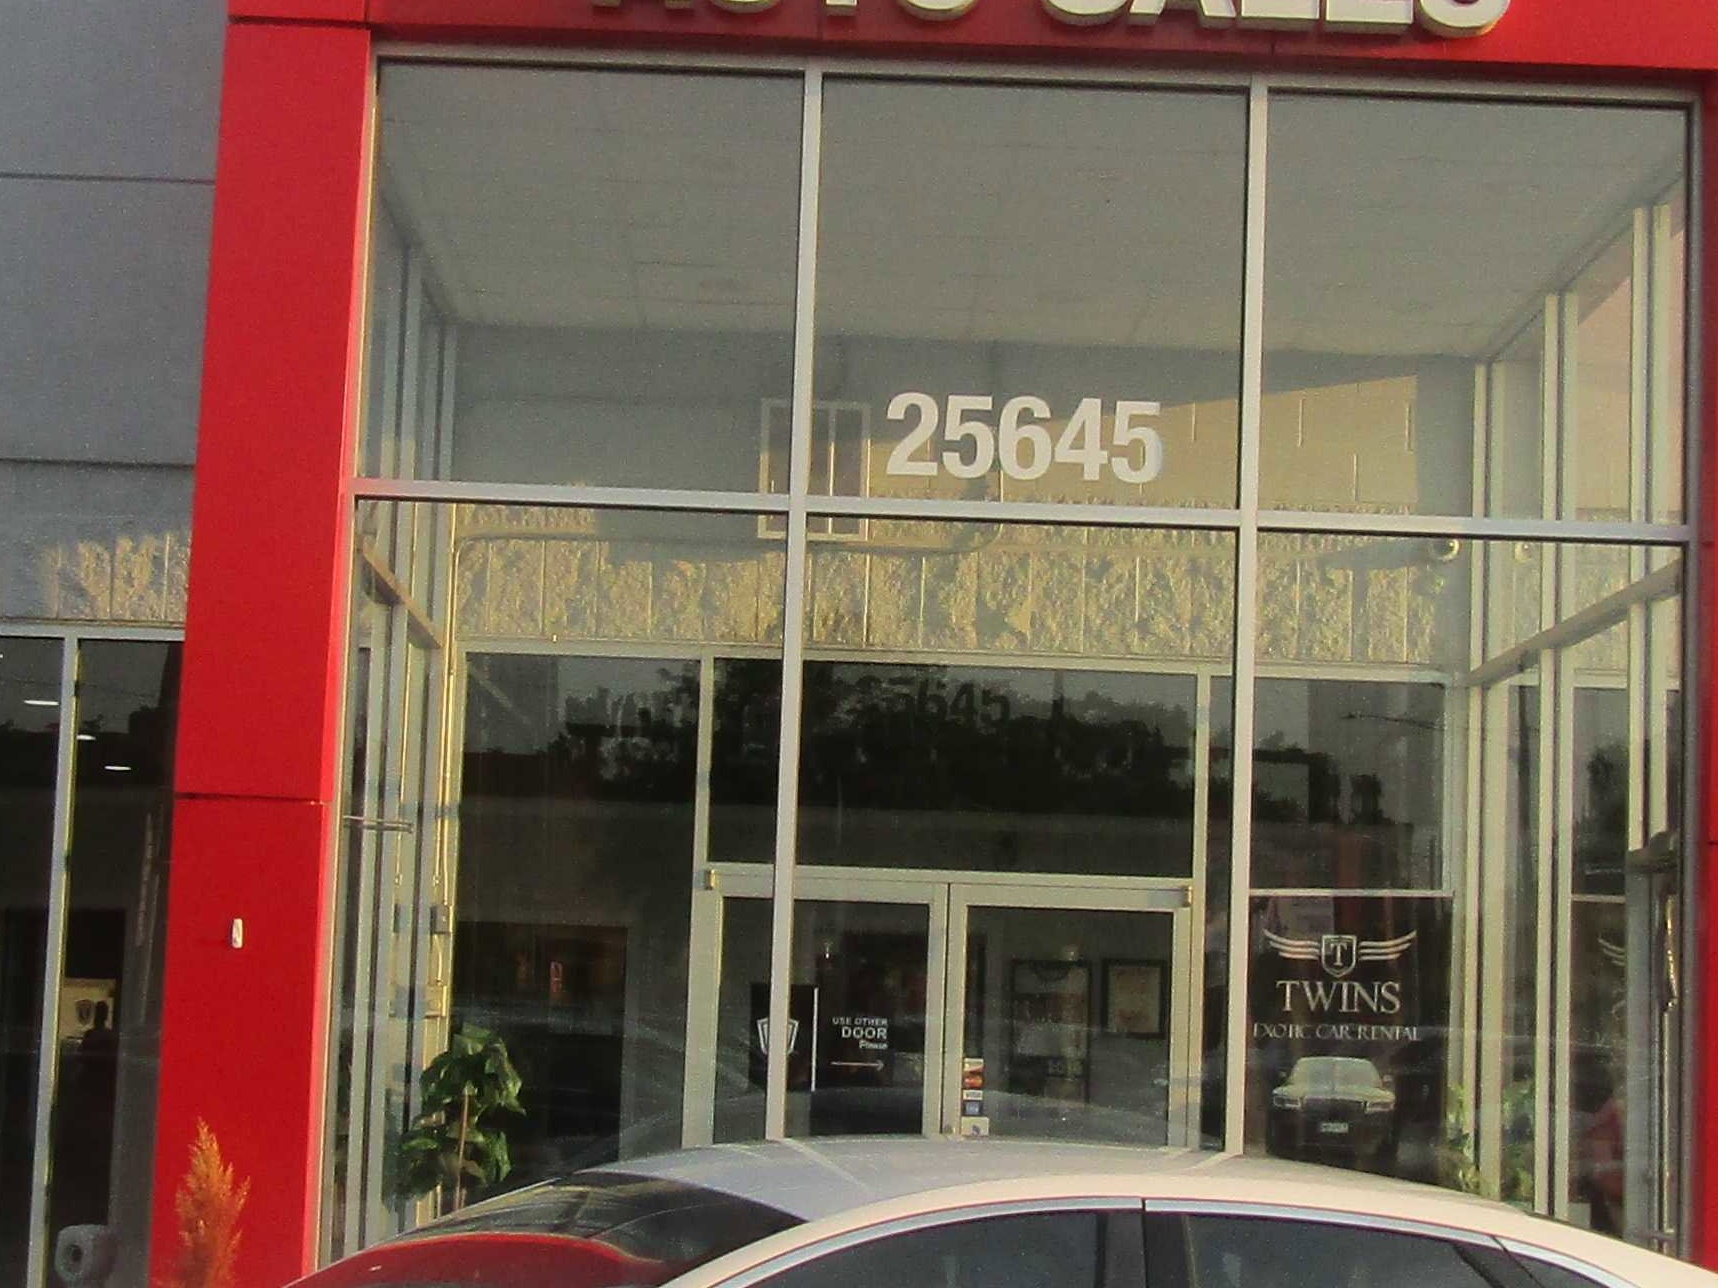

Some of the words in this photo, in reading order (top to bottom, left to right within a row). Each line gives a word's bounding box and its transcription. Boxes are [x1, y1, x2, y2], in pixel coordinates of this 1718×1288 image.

[886, 392, 1163, 484] 25645
[1275, 980, 1402, 1013] TWINS
[841, 1026, 888, 1040] DOOR
[1316, 1023, 1352, 1040] CAR
[1357, 1024, 1421, 1042] RENTAL
